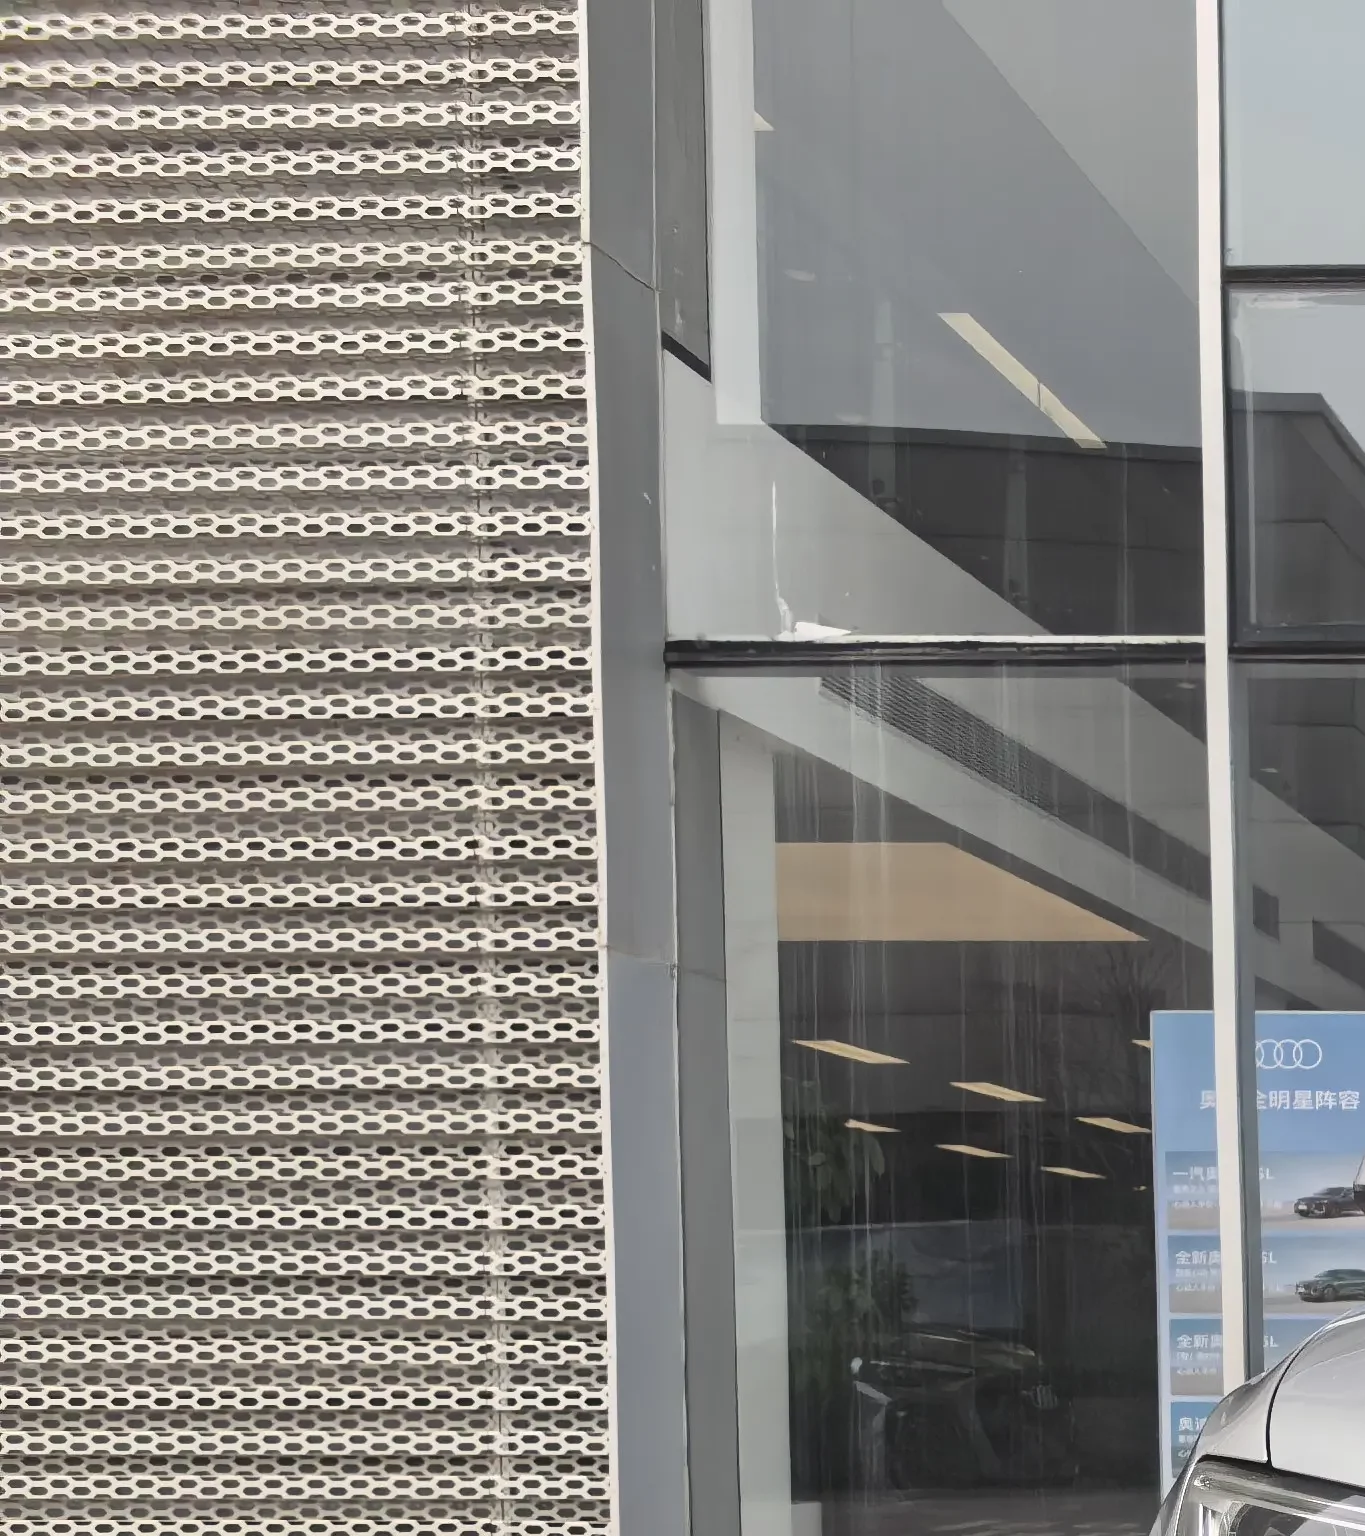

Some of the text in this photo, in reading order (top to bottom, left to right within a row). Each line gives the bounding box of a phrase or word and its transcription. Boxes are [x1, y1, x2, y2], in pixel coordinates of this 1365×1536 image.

[1200, 1089, 1361, 1111] 奥明星阵容
